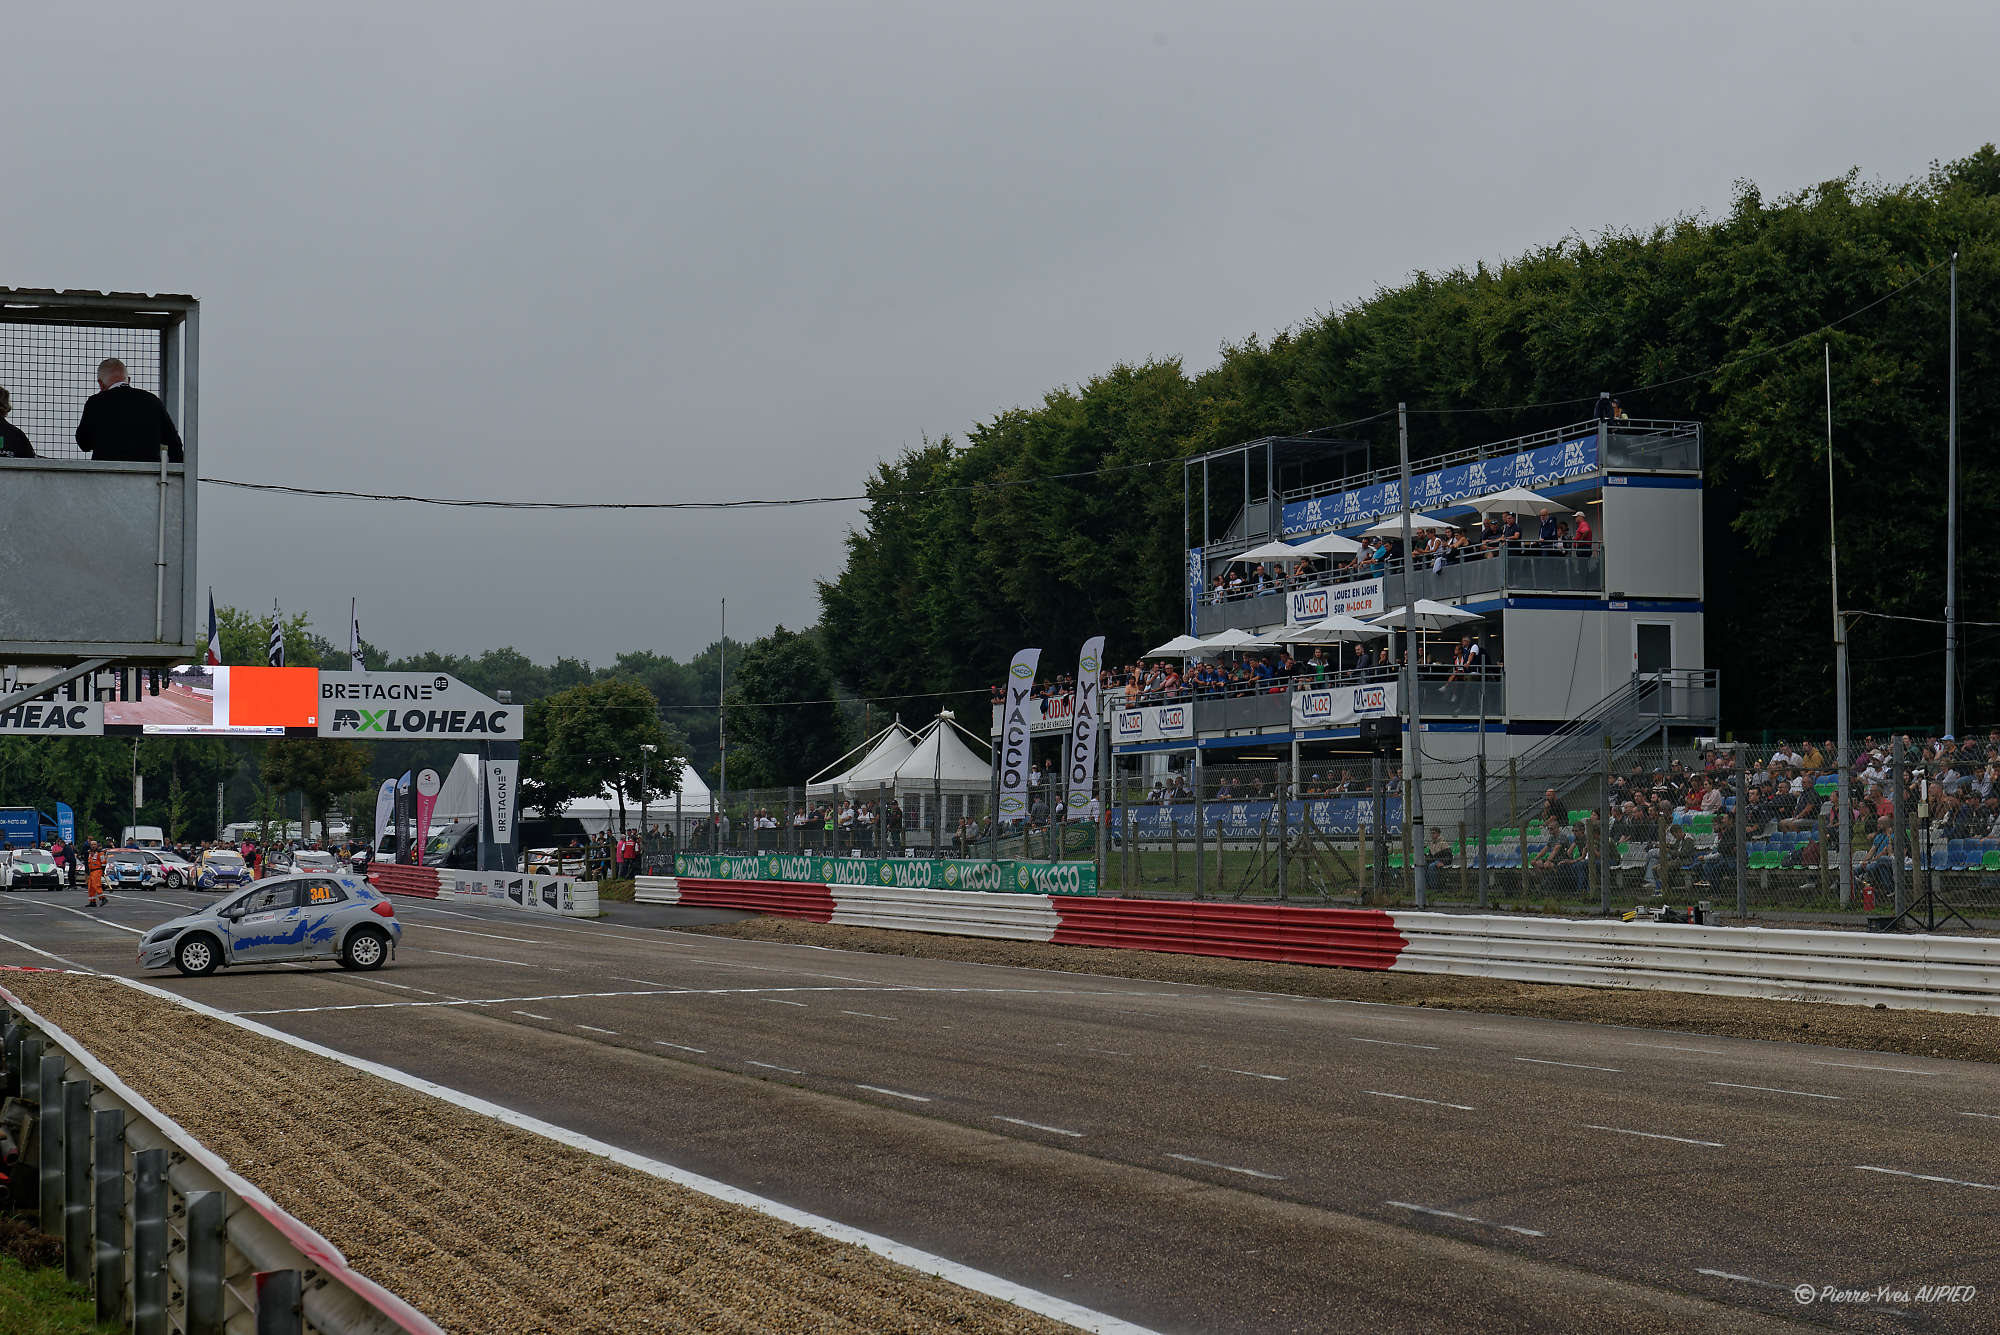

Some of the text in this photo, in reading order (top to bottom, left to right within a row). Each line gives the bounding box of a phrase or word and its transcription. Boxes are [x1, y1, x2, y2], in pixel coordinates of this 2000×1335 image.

[1334, 584, 1378, 600] LOUEZ EN LIGNE
[1334, 603, 1345, 614] SUR
[322, 683, 432, 700] BRETAGNE
[1003, 687, 1029, 788] YACCO
[1072, 680, 1095, 784] YACCO
[498, 775, 506, 832] BRETAGNE
[686, 857, 711, 878] YACCO
[731, 857, 759, 880] YACCO
[780, 857, 811, 880] YACCO
[834, 859, 868, 884] YACCO
[894, 861, 931, 887] YACCO
[960, 863, 1001, 889] YACCO
[1032, 865, 1081, 893] YACCO
[310, 887, 330, 900] 341
